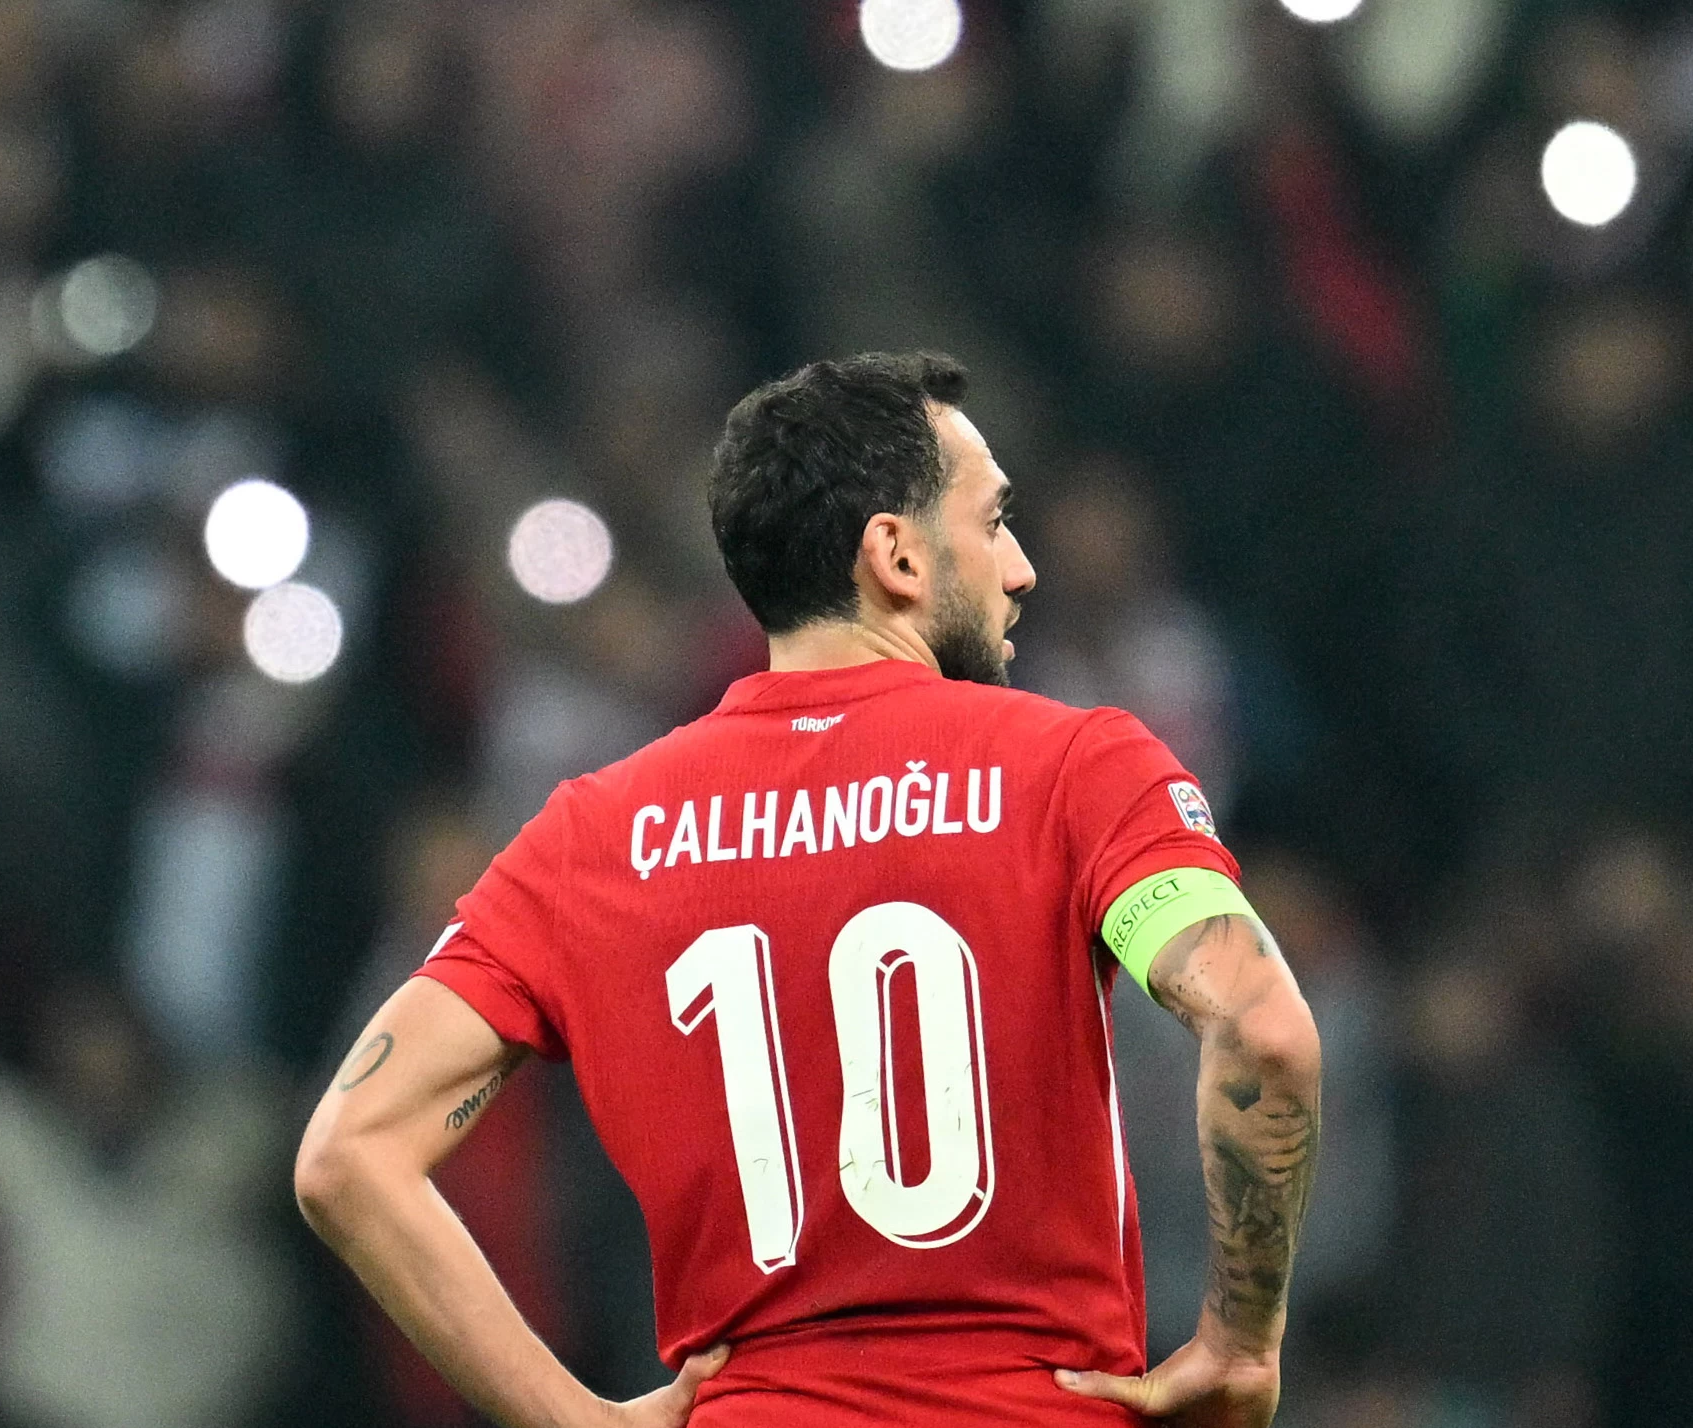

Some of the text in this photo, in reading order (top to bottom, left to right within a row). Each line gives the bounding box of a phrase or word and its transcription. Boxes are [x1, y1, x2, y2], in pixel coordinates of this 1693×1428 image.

[630, 760, 1001, 880] ÇALHANOĞLU
[1112, 878, 1181, 954] RESPECT
[665, 901, 995, 1274] 10
